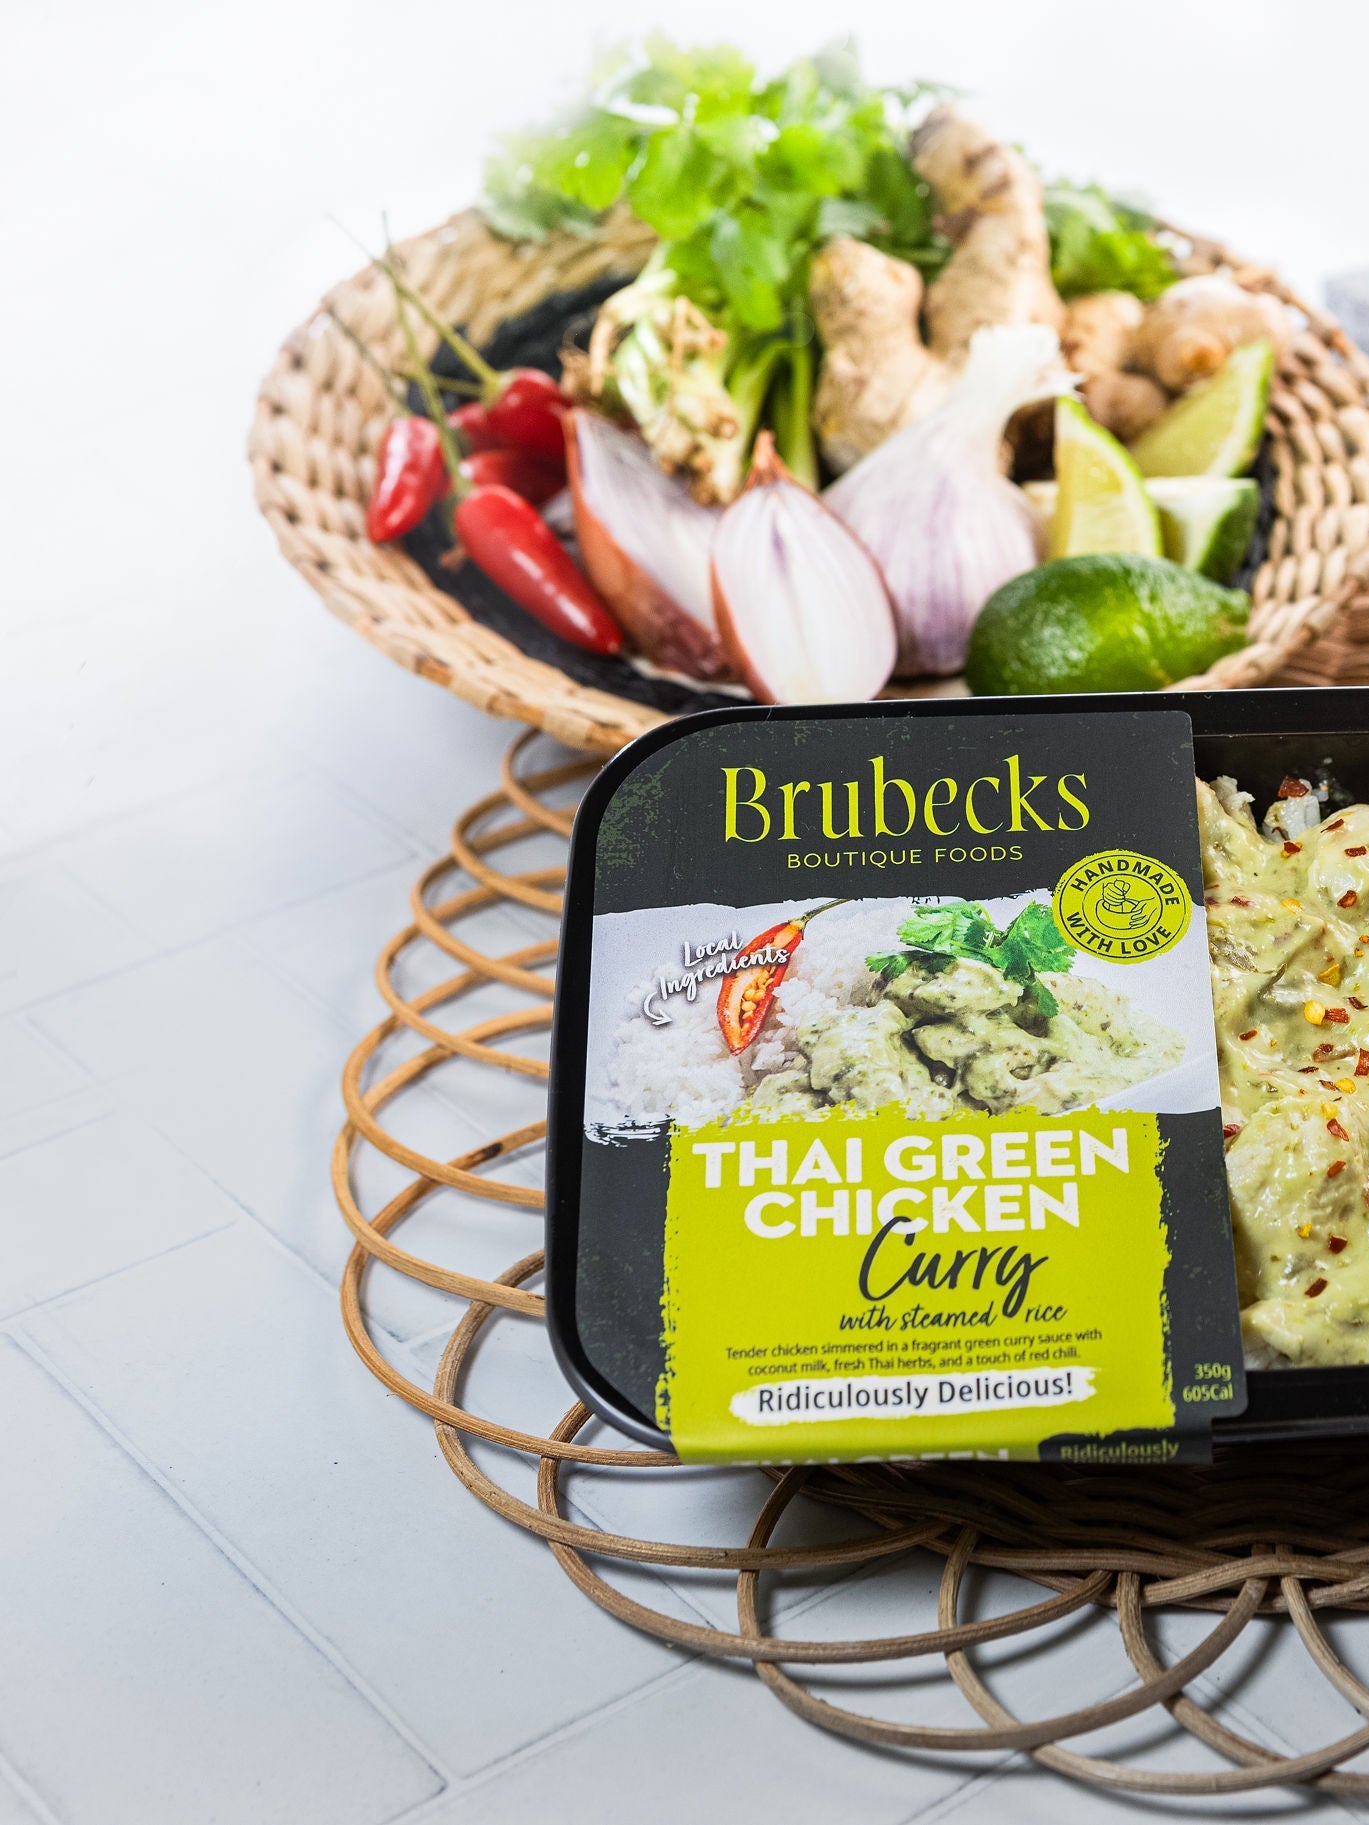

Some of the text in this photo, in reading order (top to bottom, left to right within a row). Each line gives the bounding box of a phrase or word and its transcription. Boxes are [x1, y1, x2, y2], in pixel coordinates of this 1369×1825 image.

[721, 754, 1090, 842] Brubecks
[787, 846, 1023, 868] BOUTIQUE FOODS
[1070, 859, 1180, 905] HANDMADE
[684, 931, 743, 967] Local
[1067, 912, 1171, 954] WITH LOVE
[660, 943, 790, 1001] Ingredients
[692, 1128, 1130, 1188] THAI GREEN
[744, 1183, 1080, 1239] CHICKEN
[858, 1216, 1049, 1318] Curry
[840, 1301, 1067, 1331] with steamed rice
[727, 1328, 1102, 1360] Tender chicken simmered in a fragrant green curry sauce with
[748, 1346, 1081, 1376] coconut milk, fresh Thai herbs, and a touch of red chilli.
[1194, 1363, 1232, 1382] 350g
[759, 1372, 1073, 1412] Ridiculously Delicious!
[1182, 1382, 1234, 1403] 605Cal
[1059, 1439, 1180, 1461] Ridiculously
